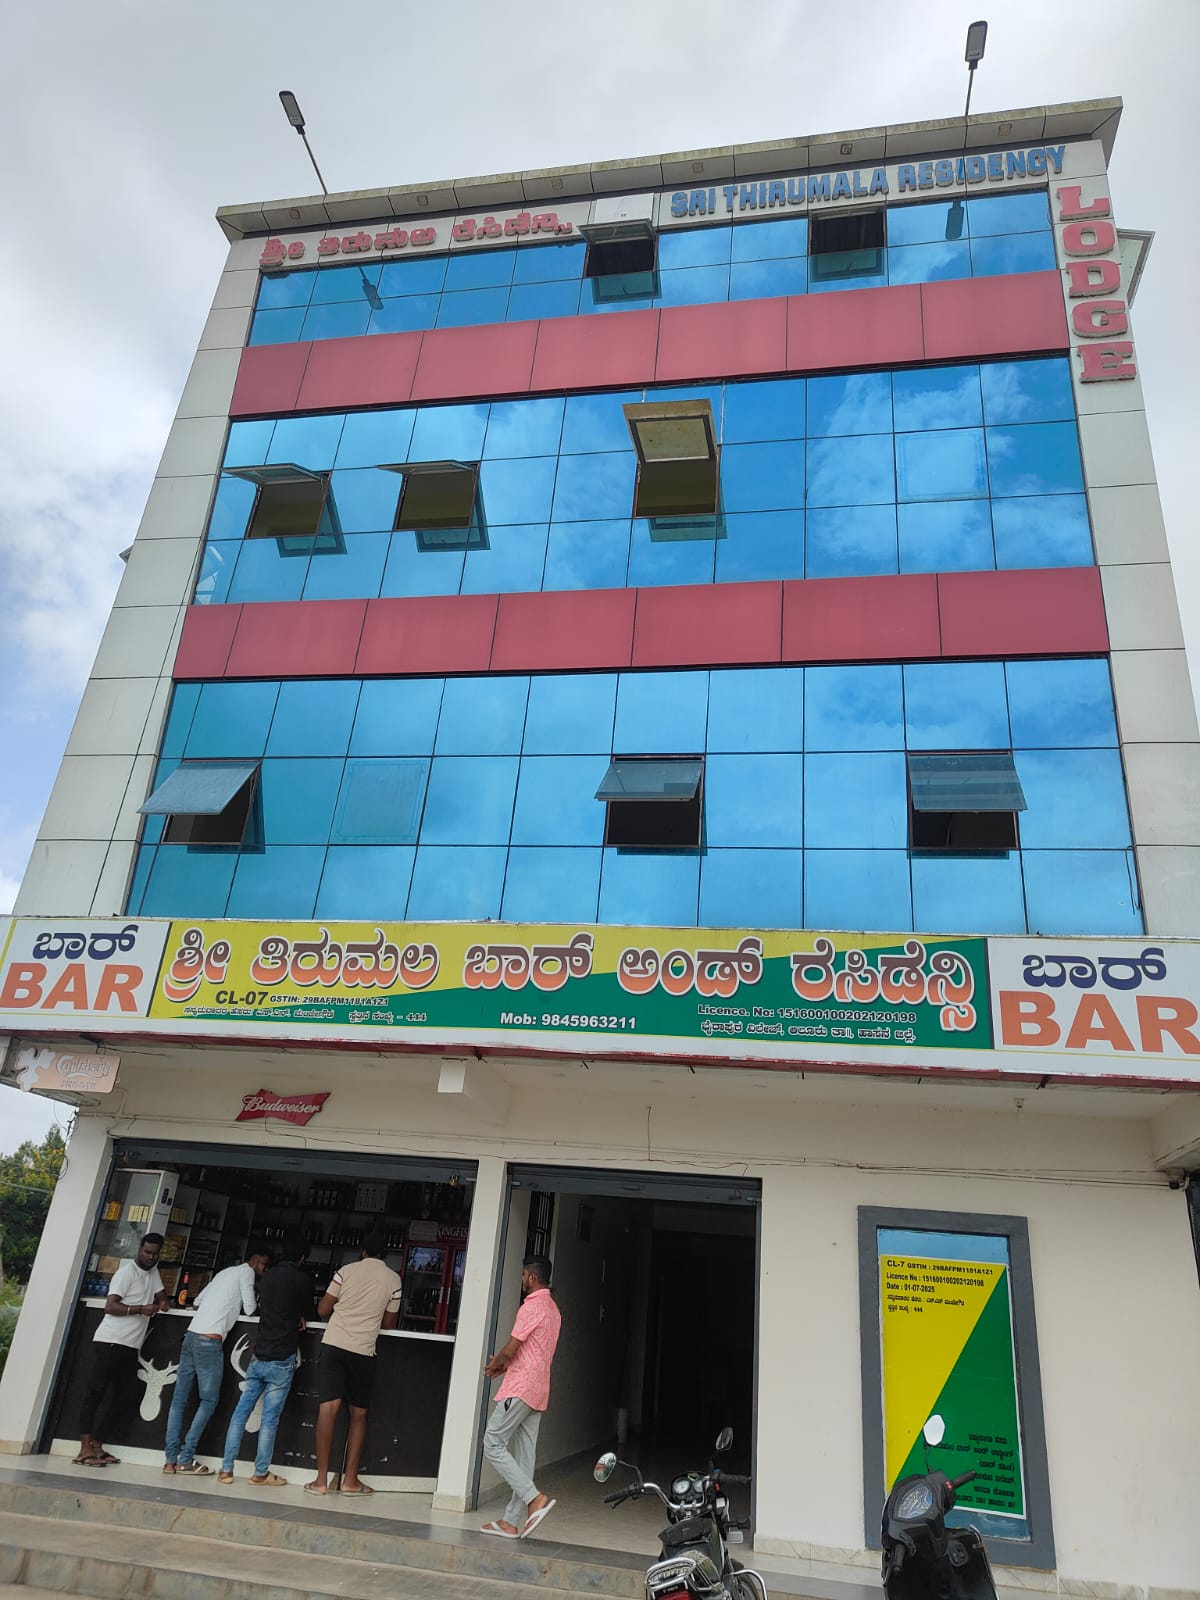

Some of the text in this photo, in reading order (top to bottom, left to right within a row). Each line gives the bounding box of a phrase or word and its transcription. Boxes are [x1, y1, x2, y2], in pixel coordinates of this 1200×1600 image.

[671, 145, 1066, 218] SRI THIRUMALA RESIDENCY
[317, 227, 437, 256] ತಿರುಮಲ
[1056, 185, 1136, 384] LODGE
[32, 924, 139, 960] ಬಾರ್
[163, 928, 977, 1031] ಶ್ರೀ ತಿರುಮಲ ಬಾರ್ ಅಂಡ್ ರೆಸಿಡೆನ್ಸಿ
[1022, 947, 1167, 991] ಬಾರ್
[0, 962, 144, 1013] BAR
[215, 990, 269, 1006] CL-07
[270, 995, 300, 1004] GSTIN:
[500, 1012, 637, 1029] Mob: 9845963211
[753, 1006, 775, 1018] No:
[777, 1008, 917, 1023] 151600100202120198
[999, 990, 1200, 1055] BAR
[241, 1095, 321, 1114] Budweiser
[886, 1260, 905, 1268] CL-7
[886, 1272, 908, 1281] Licence
[886, 1282, 900, 1290] Date
